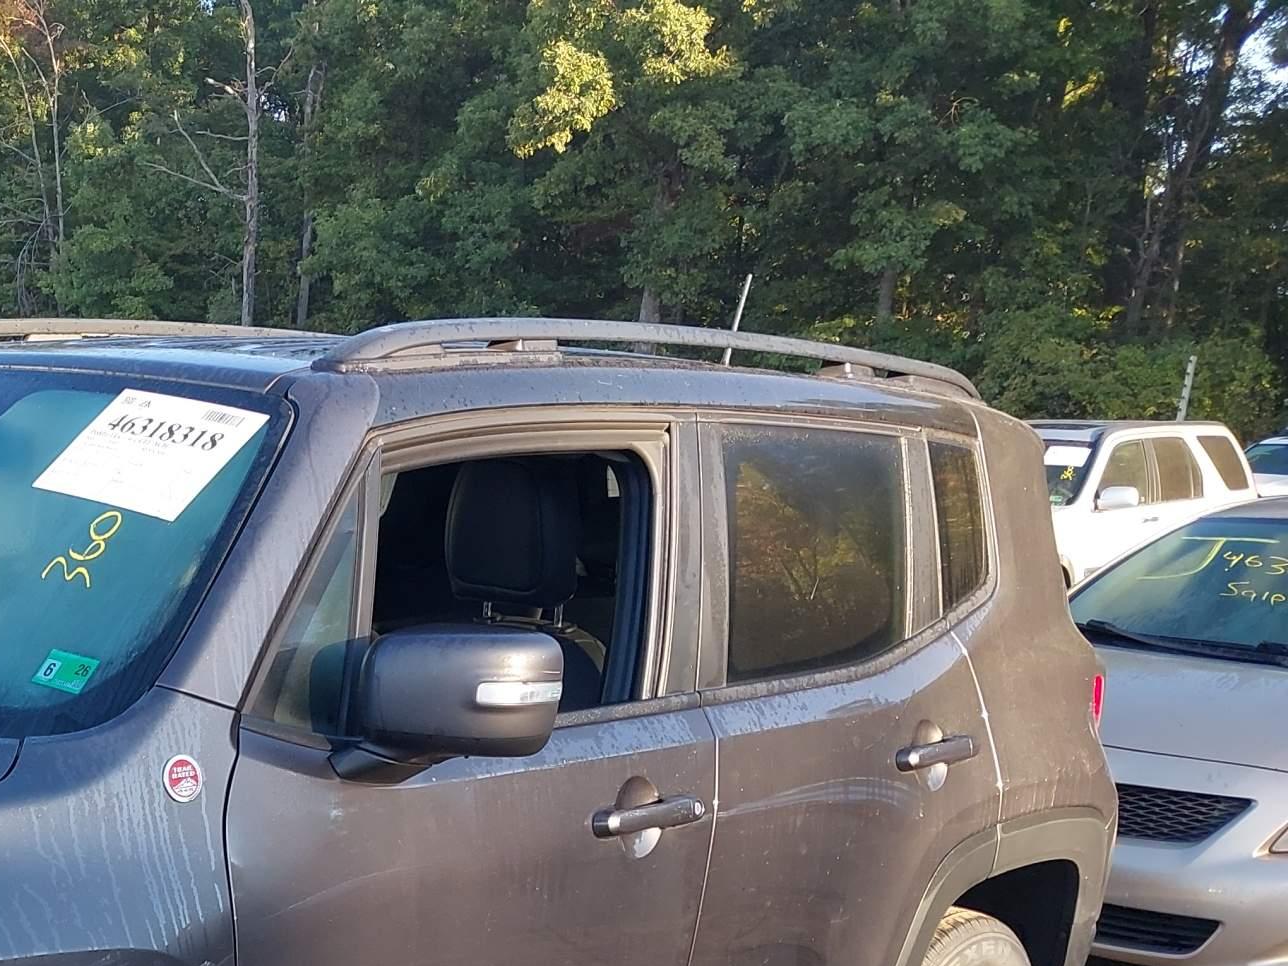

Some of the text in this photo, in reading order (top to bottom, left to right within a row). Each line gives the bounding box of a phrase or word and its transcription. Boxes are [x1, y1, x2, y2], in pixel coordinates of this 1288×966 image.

[107, 414, 225, 451] 46318318
[43, 662, 91, 677] 6 26
